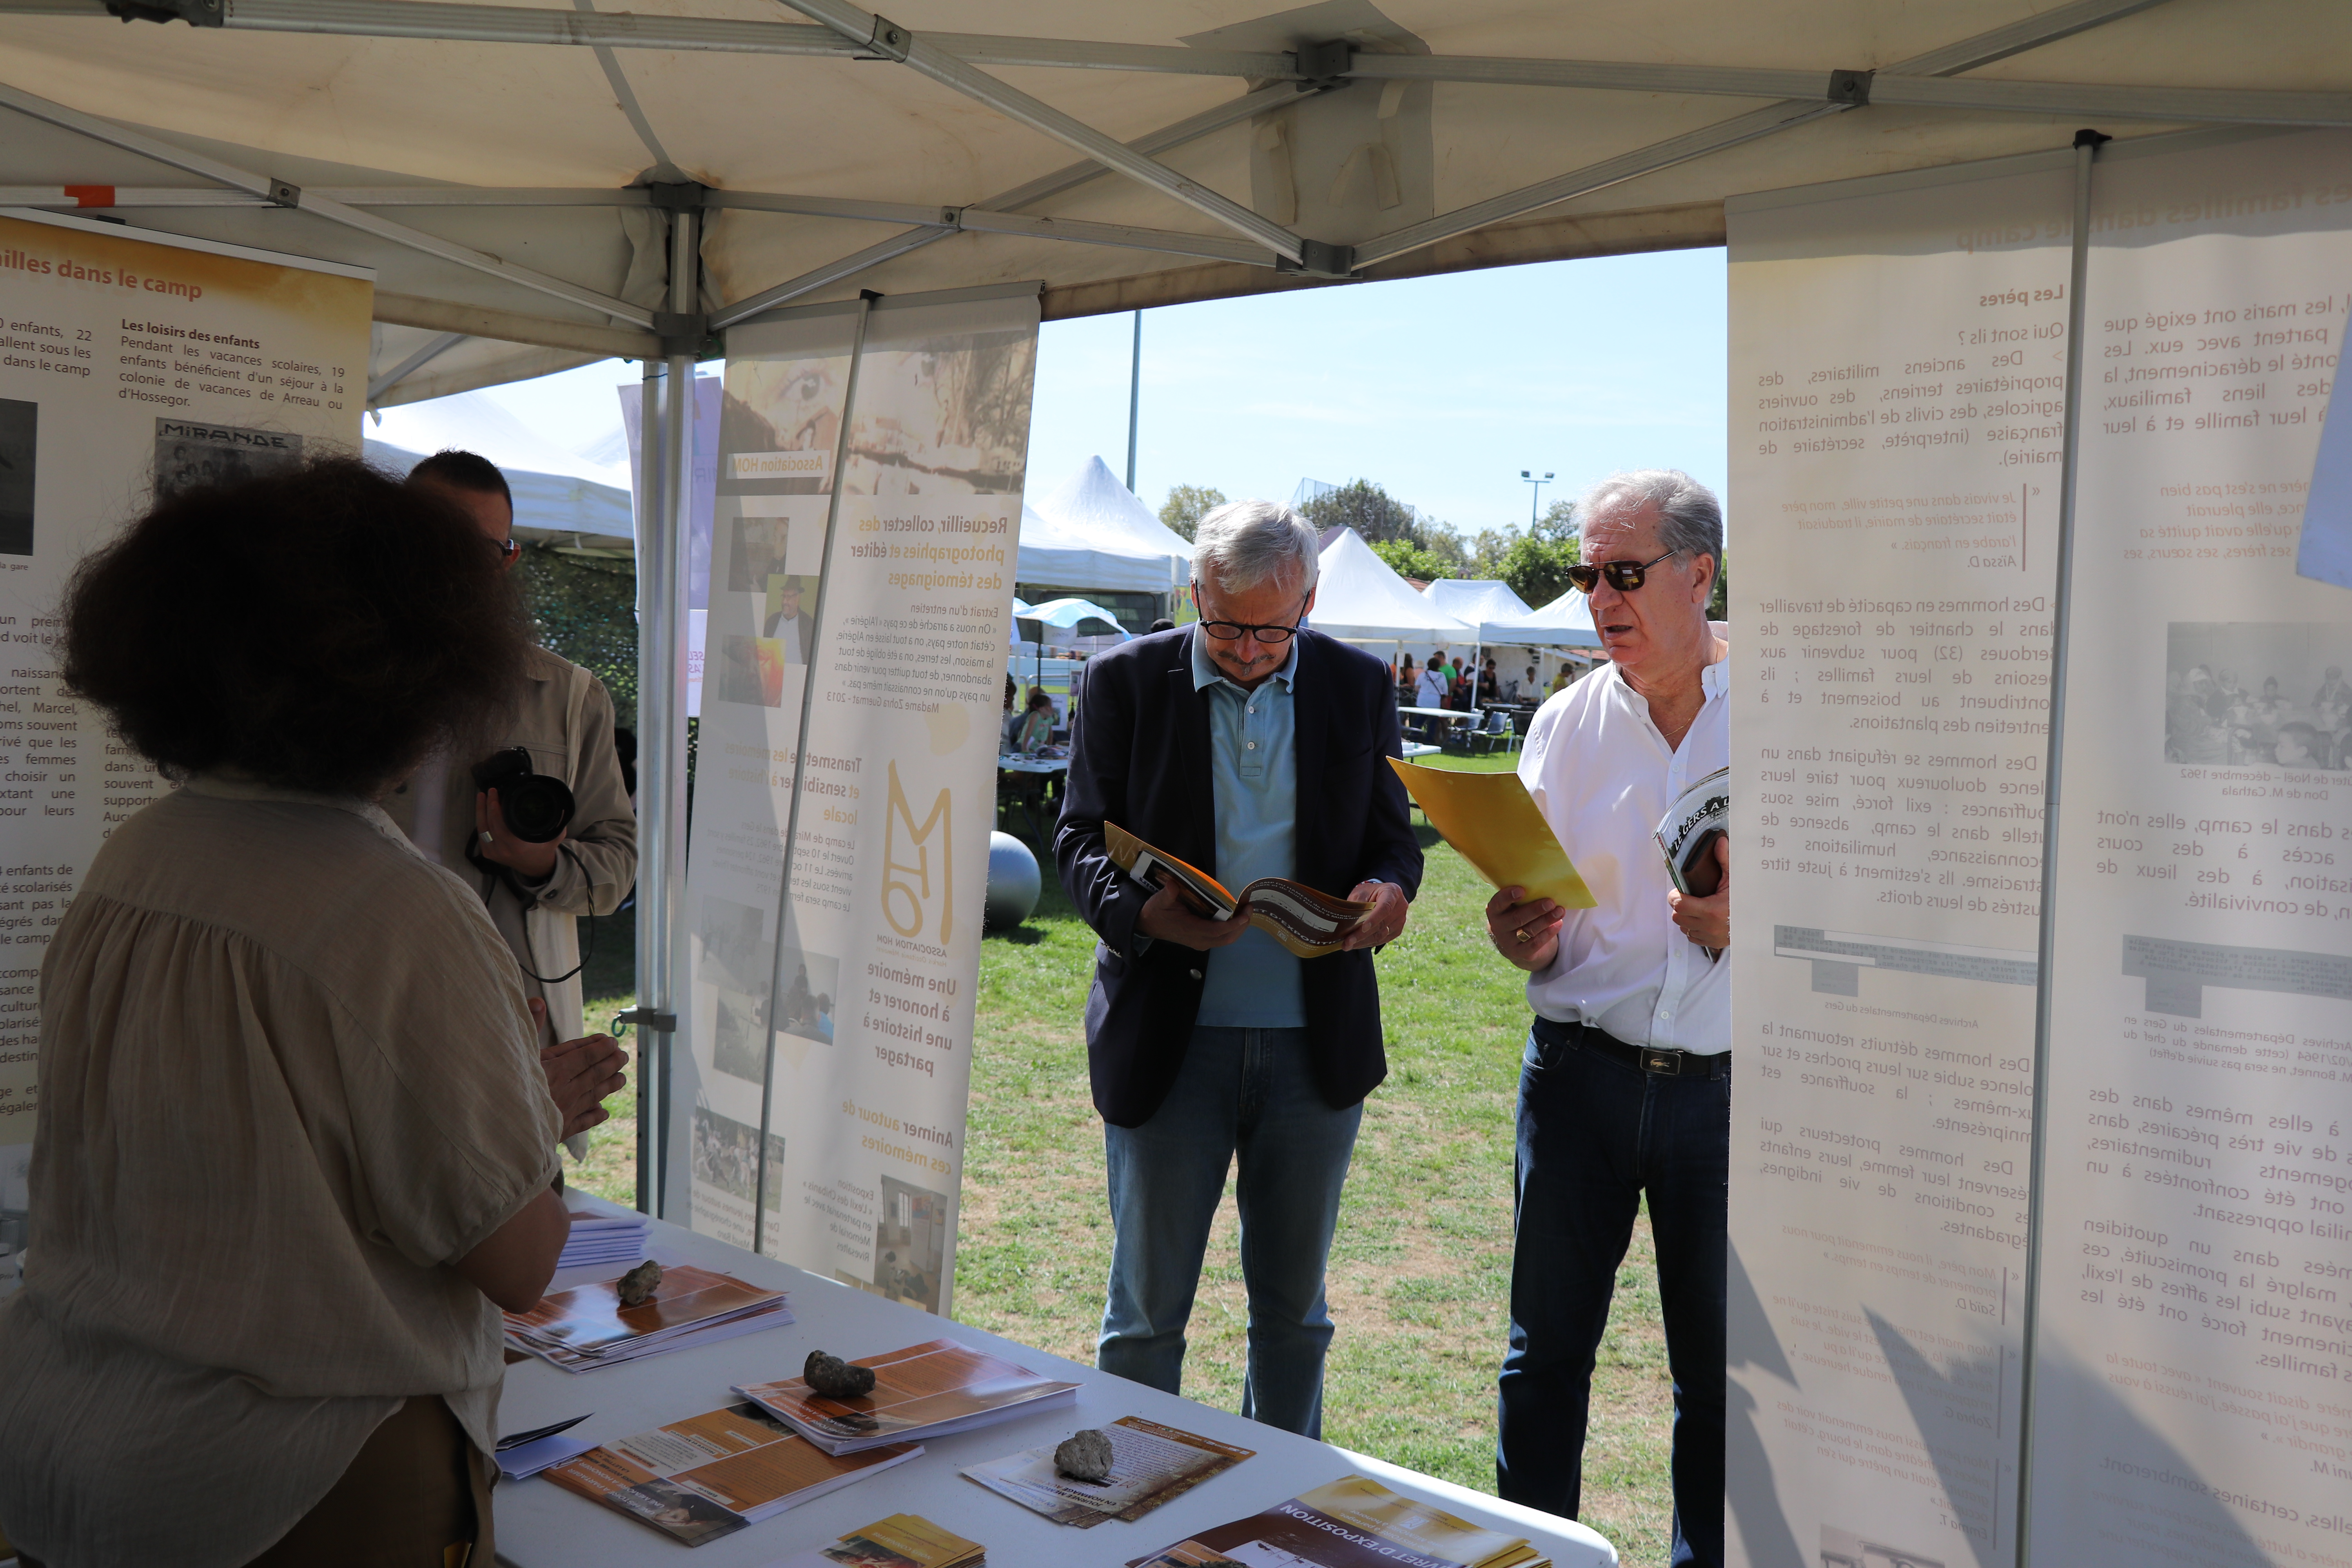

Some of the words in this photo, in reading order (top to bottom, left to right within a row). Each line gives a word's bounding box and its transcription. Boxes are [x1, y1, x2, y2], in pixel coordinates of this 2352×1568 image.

[58, 260, 112, 284] dans
[119, 270, 137, 288] le
[143, 279, 201, 302] camp
[10, 321, 64, 338] enfants,
[76, 329, 92, 341] 22
[121, 319, 144, 332] Les
[147, 322, 185, 338] loisirs
[188, 329, 211, 341] des
[212, 334, 260, 349] enfants
[40, 344, 69, 356] sous
[74, 346, 91, 359] les
[120, 336, 173, 353] Pendant
[183, 344, 199, 357] les
[210, 351, 262, 366] vacances
[272, 360, 321, 376] scolaires,
[332, 367, 345, 377] 19
[3, 354, 36, 368] dans
[40, 359, 51, 370] le
[54, 364, 90, 378] camp
[120, 355, 166, 369] enfants
[174, 360, 240, 379] bénéficient
[247, 371, 272, 384] d'un
[280, 377, 314, 390] séjour
[320, 381, 327, 391] à
[334, 383, 343, 394] la
[13, 633, 38, 643] voit
[41, 633, 53, 644] le
[33, 702, 78, 715] Marcel,
[27, 721, 78, 731] souvent
[28, 739, 53, 750] que
[60, 737, 77, 748] les
[25, 753, 76, 765] femmes
[5, 770, 48, 782] choisir
[104, 779, 154, 789] souvent
[51, 791, 75, 799] une
[44, 805, 74, 816] leurs
[1682, 807, 1708, 835] GERS
[1710, 802, 1720, 812] A
[6, 864, 53, 876] enfants
[57, 864, 73, 875] de
[12, 881, 72, 893] scolarisés
[31, 901, 54, 912] pas
[1286, 886, 1312, 904] HAMEAU
[1322, 907, 1352, 918] forestage
[567, 1468, 604, 1489] PARTAGER
[579, 1462, 613, 1481] HONORER
[1017, 1477, 1066, 1496] MEMORIELLE
[1060, 1487, 1105, 1503] HOMMAGE
[1067, 1493, 1103, 1507] JOURNEE
[651, 1499, 665, 1508] UNE
[1350, 1510, 1381, 1524] honorer
[911, 1549, 933, 1560] NOUS
